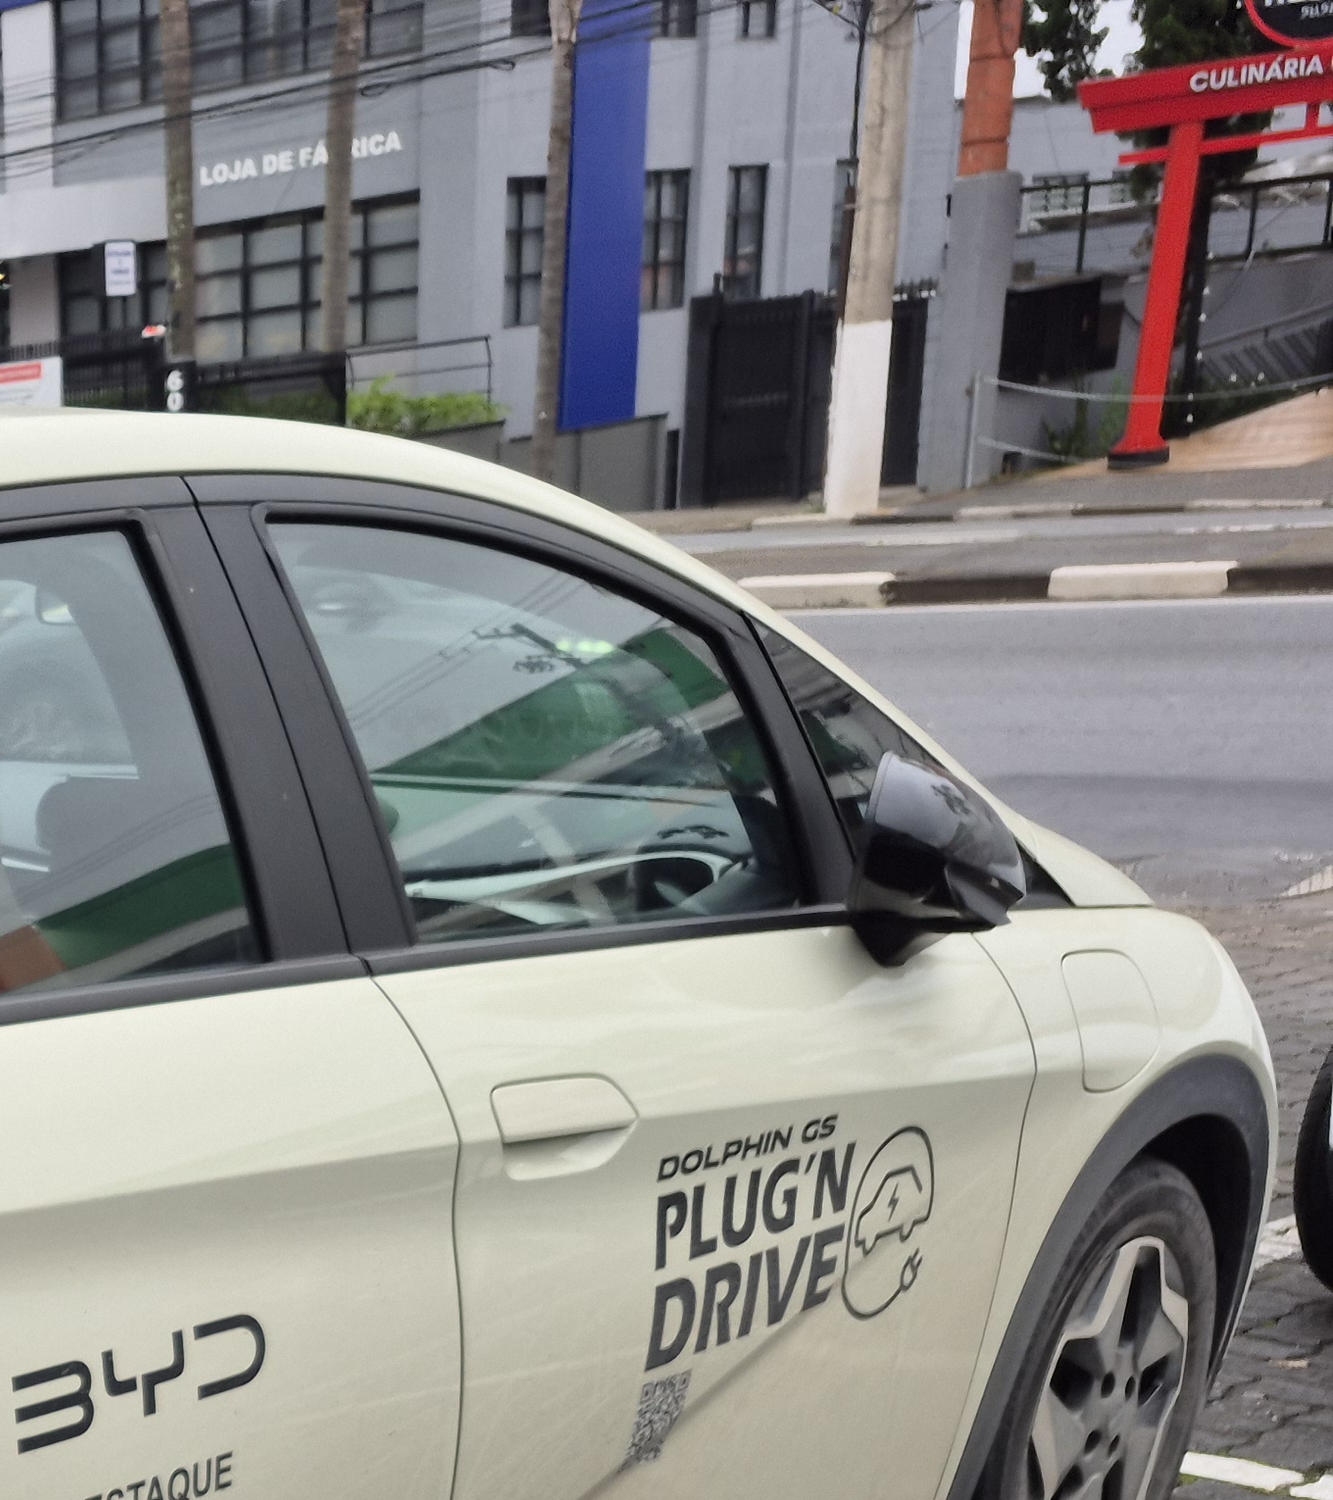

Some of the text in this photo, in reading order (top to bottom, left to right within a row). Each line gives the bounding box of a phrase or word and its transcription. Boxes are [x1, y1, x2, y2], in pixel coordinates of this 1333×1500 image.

[1190, 54, 1323, 93] CULINÁRIA
[199, 129, 402, 186] LOJA DE FÁRICA
[657, 1112, 838, 1183] DOLPHIN GS
[654, 1140, 857, 1271] PLUG'N
[644, 1223, 846, 1373] DRIVE
[11, 1313, 266, 1454] BYD
